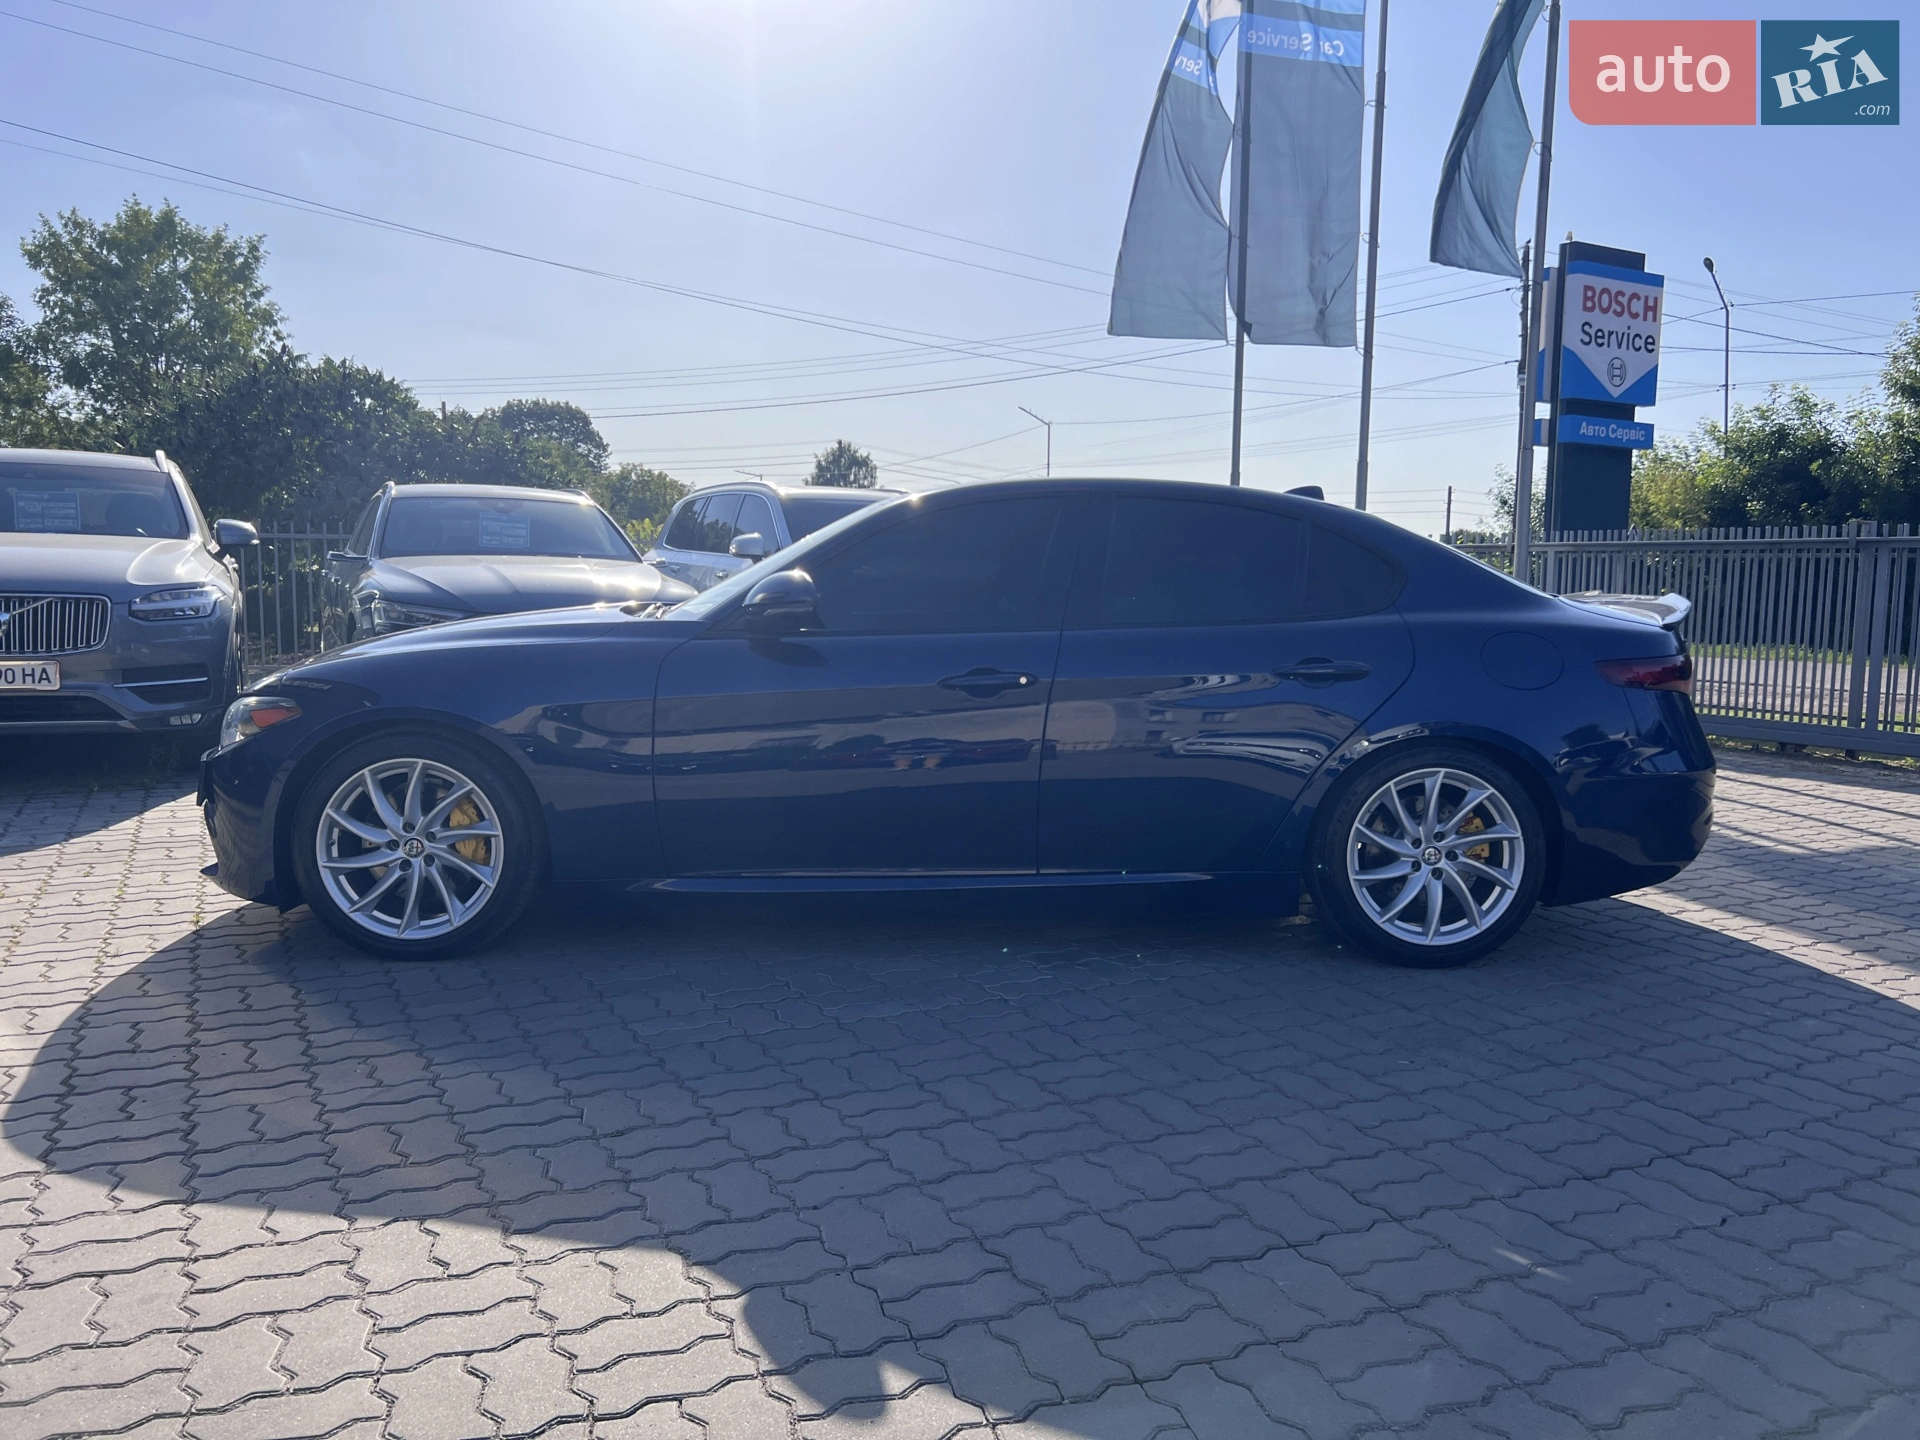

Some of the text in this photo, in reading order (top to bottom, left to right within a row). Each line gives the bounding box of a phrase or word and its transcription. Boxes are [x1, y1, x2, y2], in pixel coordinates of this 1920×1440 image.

[1581, 284, 1659, 323] BOSCH
[1579, 321, 1656, 354] Service
[1579, 421, 1645, 442] Авто Сервіс
